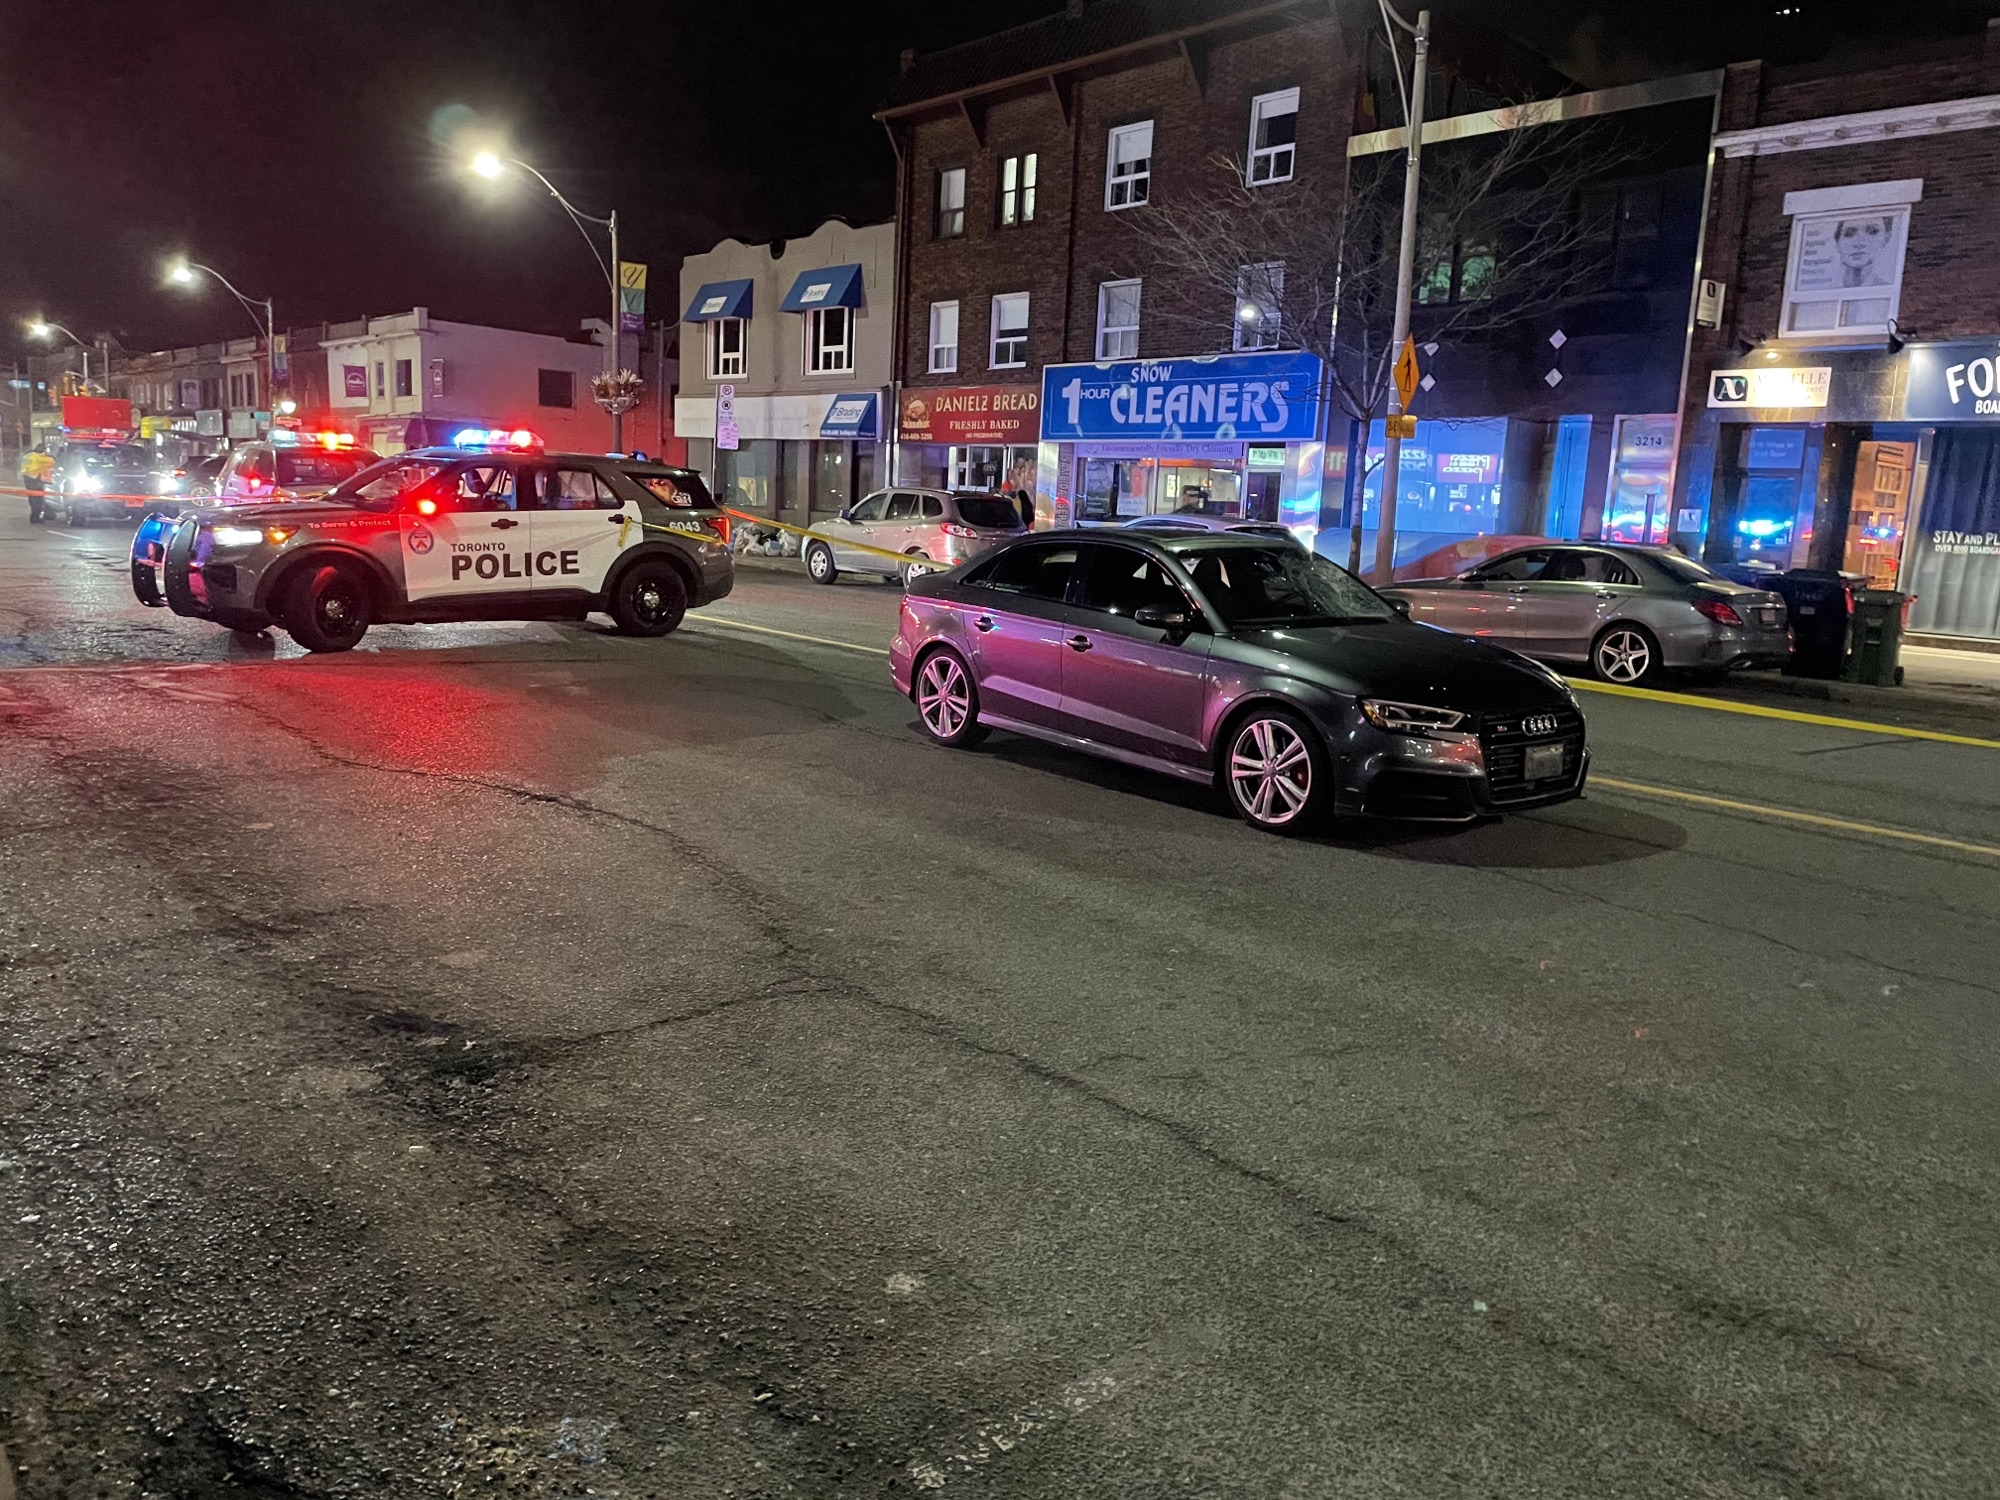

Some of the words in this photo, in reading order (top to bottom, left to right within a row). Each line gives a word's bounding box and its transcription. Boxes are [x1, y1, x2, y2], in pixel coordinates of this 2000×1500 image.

[1131, 365, 1173, 384] SNOW
[1945, 355, 2000, 404] FO
[935, 395, 989, 413] DANIELZ
[993, 393, 1038, 411] BREAD
[1062, 378, 1082, 424] 1
[1080, 388, 1111, 400] HOUR
[1110, 381, 1289, 432] CLEANERS
[1975, 399, 2000, 414] BOA
[836, 407, 862, 419] Brading
[949, 420, 988, 430] FRESHLY
[990, 419, 1020, 430] BAKED
[1635, 436, 1662, 447] 3214
[1186, 445, 1199, 455] Dry
[1202, 445, 1234, 455] Cleaning
[1060, 456, 1070, 481] SAME
[669, 521, 701, 532] 6043
[1933, 530, 1964, 544] STAY
[1964, 534, 1983, 545] AND
[451, 542, 506, 553] TORONTO
[1935, 544, 1952, 553] OVER
[451, 551, 580, 580] POLICE
